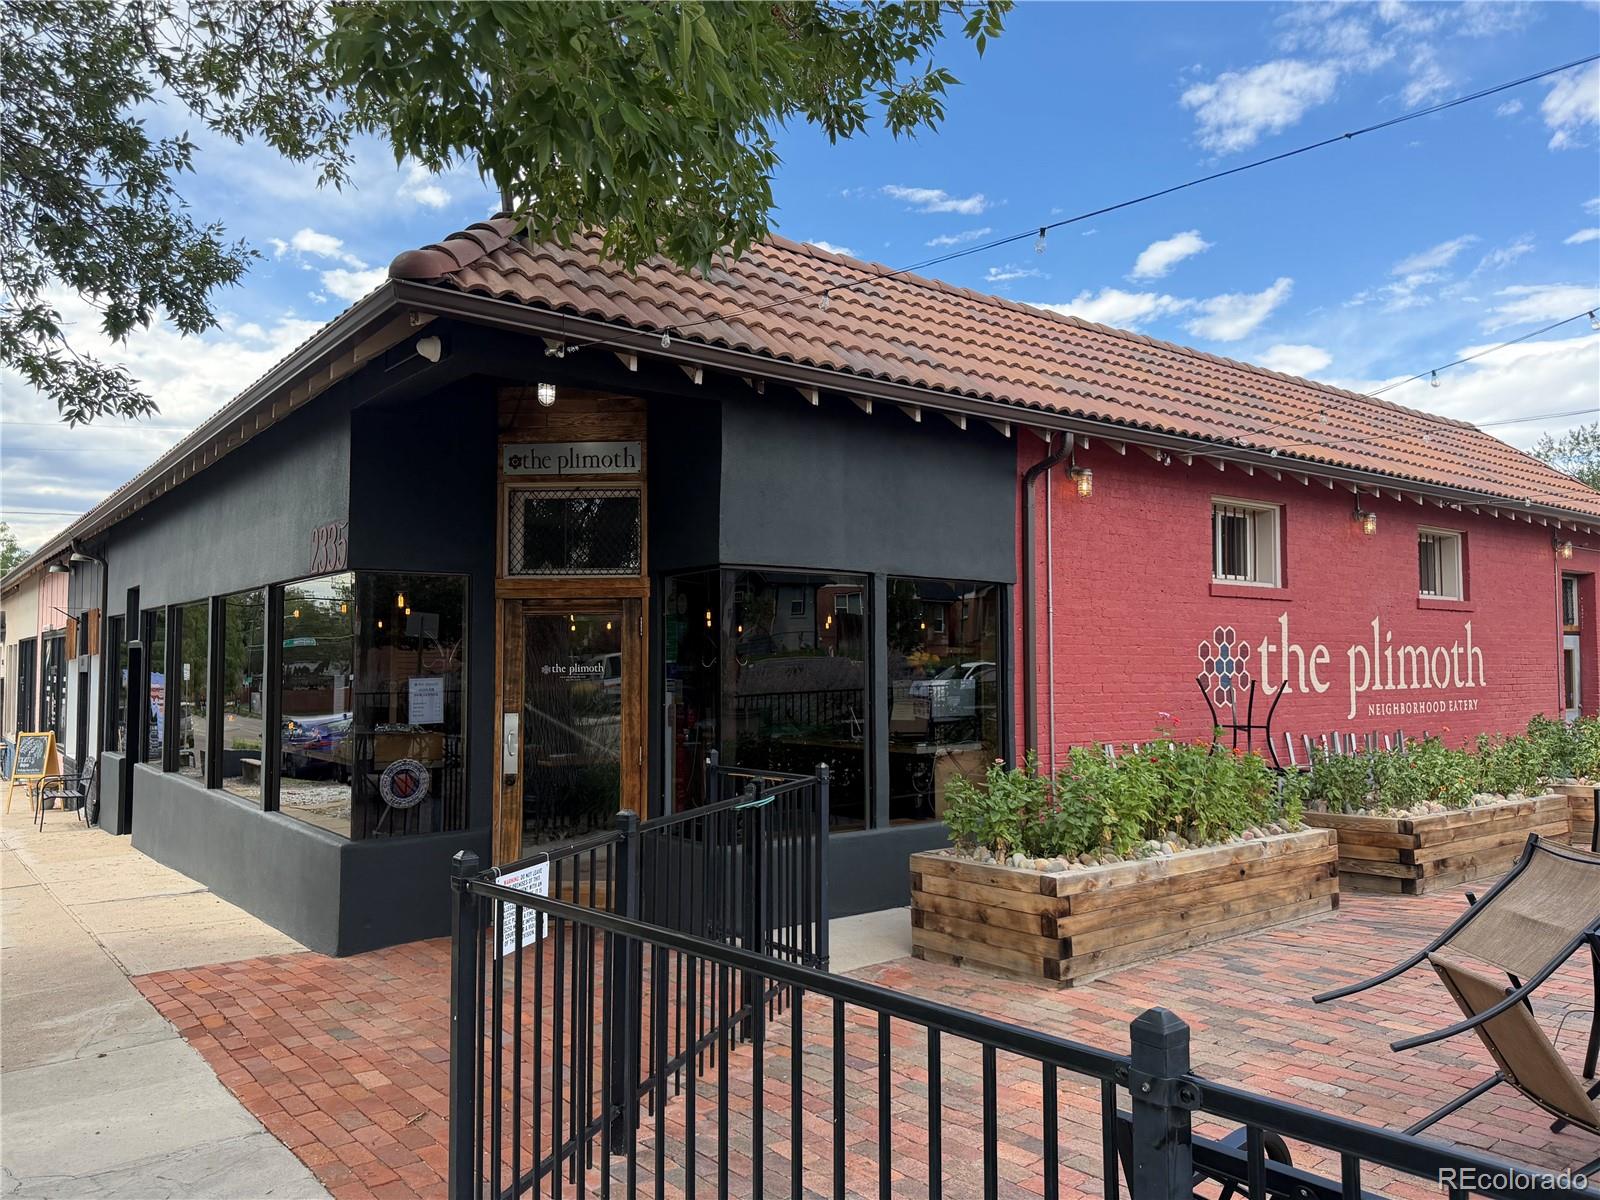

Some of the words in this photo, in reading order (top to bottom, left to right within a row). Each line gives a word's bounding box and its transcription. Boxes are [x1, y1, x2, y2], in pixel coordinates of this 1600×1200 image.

[523, 448, 552, 470] the
[558, 446, 636, 474] plimoth
[310, 520, 349, 576] 2335
[552, 663, 566, 673] the
[569, 662, 605, 676] plimoth
[1257, 611, 1331, 696] the
[1346, 615, 1487, 720] plimoth
[1367, 700, 1446, 716] NEIGHBORHOOD
[1449, 699, 1479, 712] EATERY
